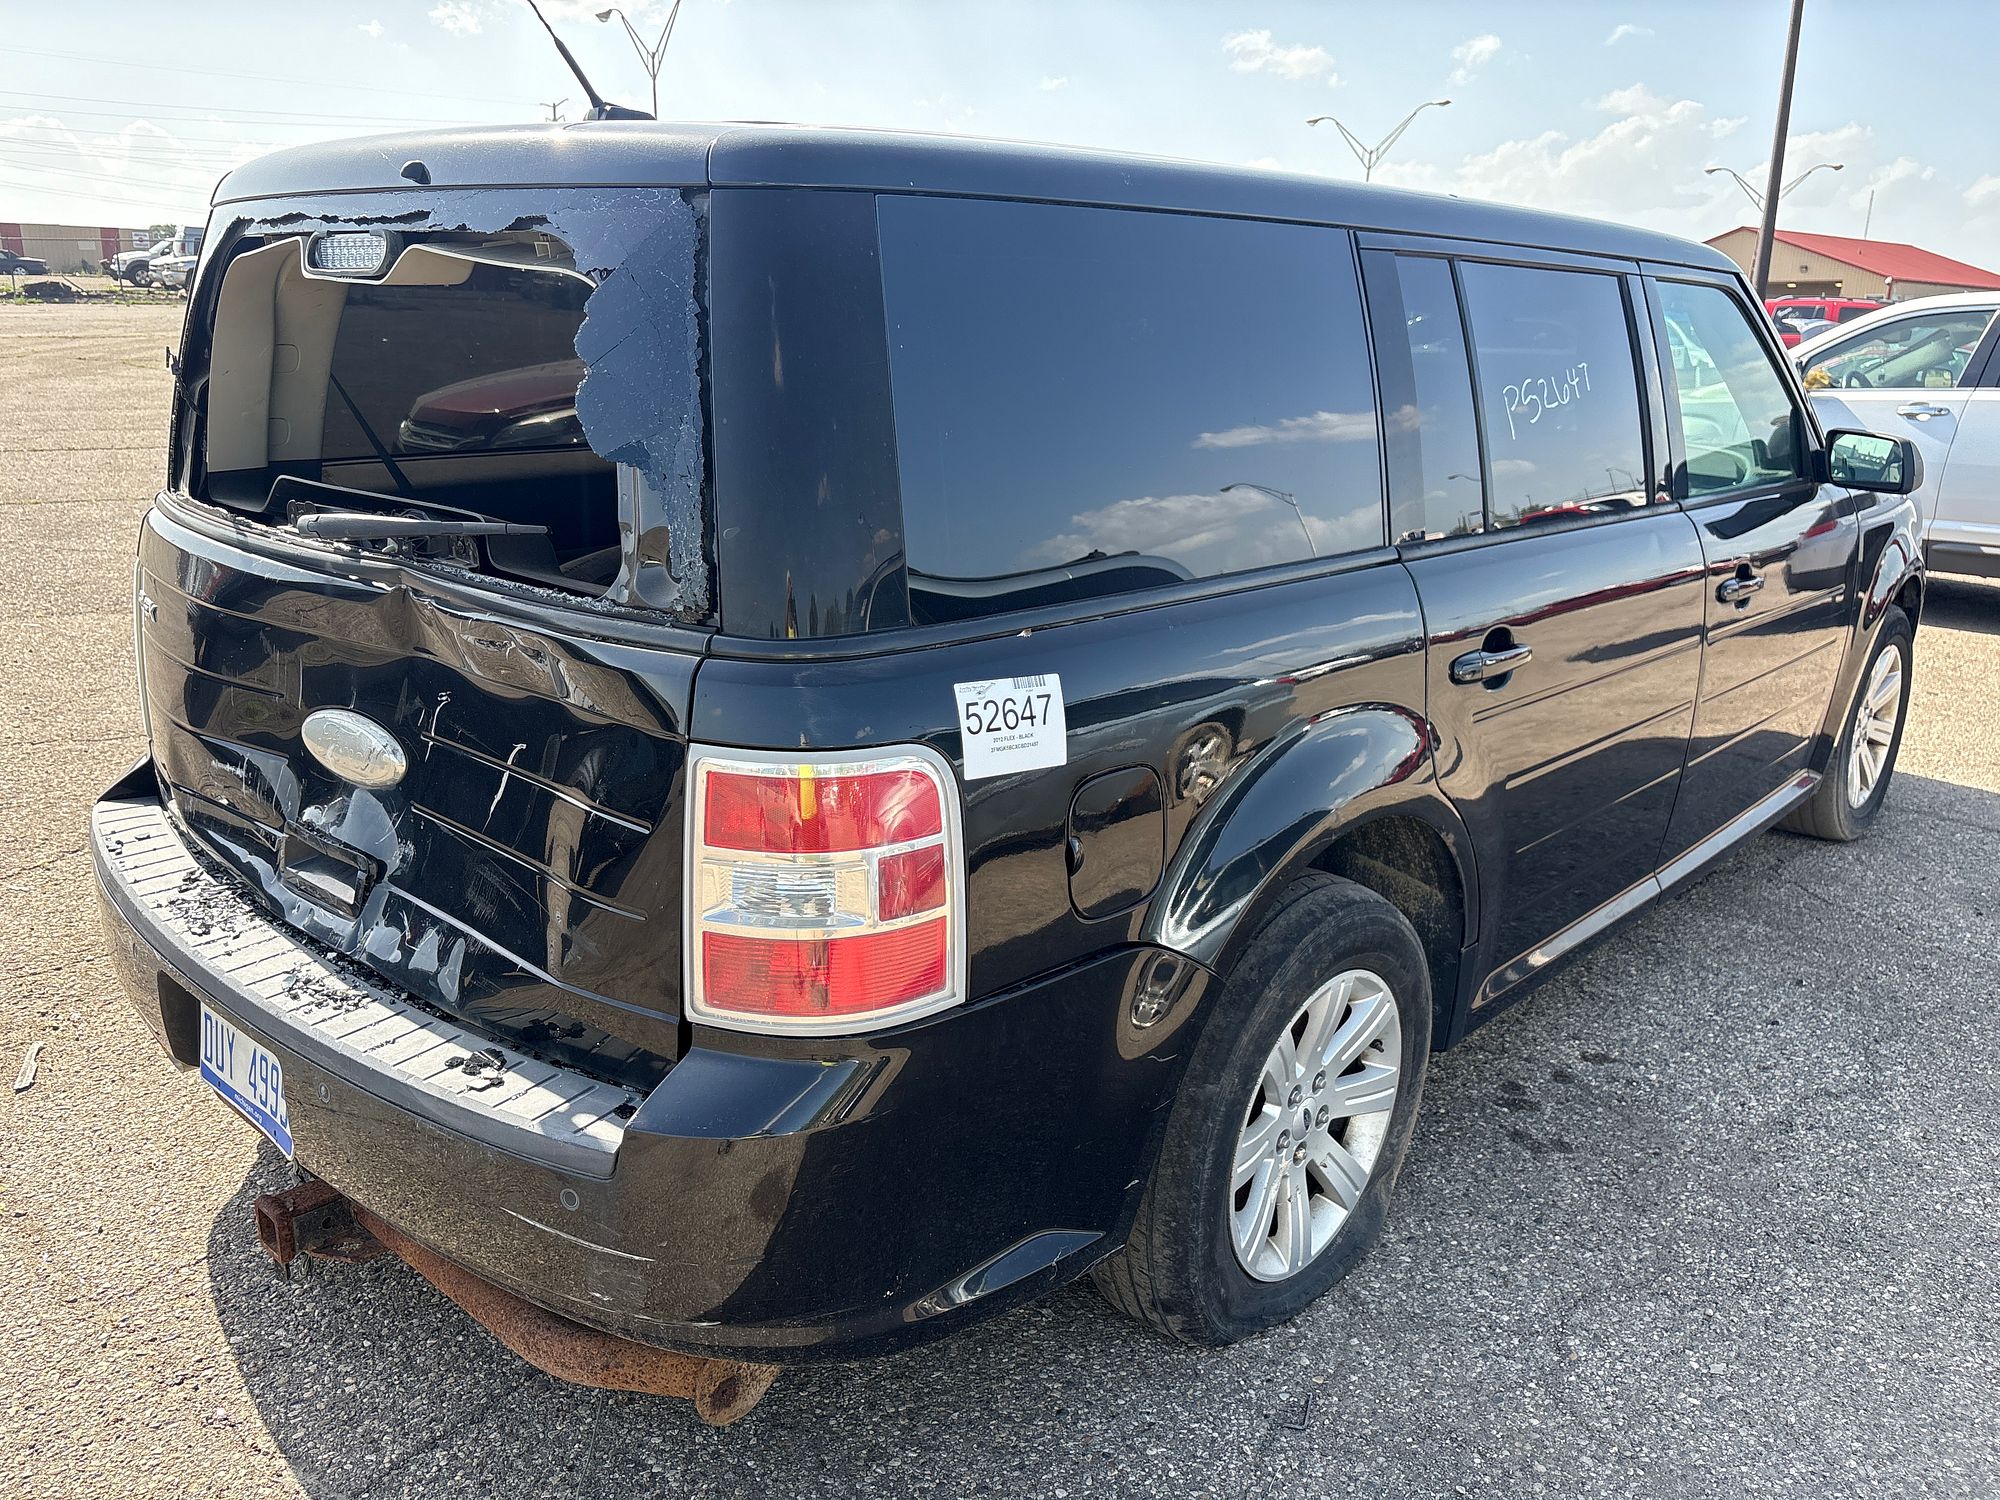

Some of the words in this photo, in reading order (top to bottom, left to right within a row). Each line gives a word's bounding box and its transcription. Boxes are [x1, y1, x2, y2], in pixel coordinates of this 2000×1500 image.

[1502, 362, 1591, 440] P52647
[965, 693, 1052, 736] 52647
[1004, 734, 1016, 742] FLEX
[1019, 732, 1034, 740] BLACK
[204, 1011, 236, 1081] DUY
[234, 1092, 263, 1124] michigan.org
